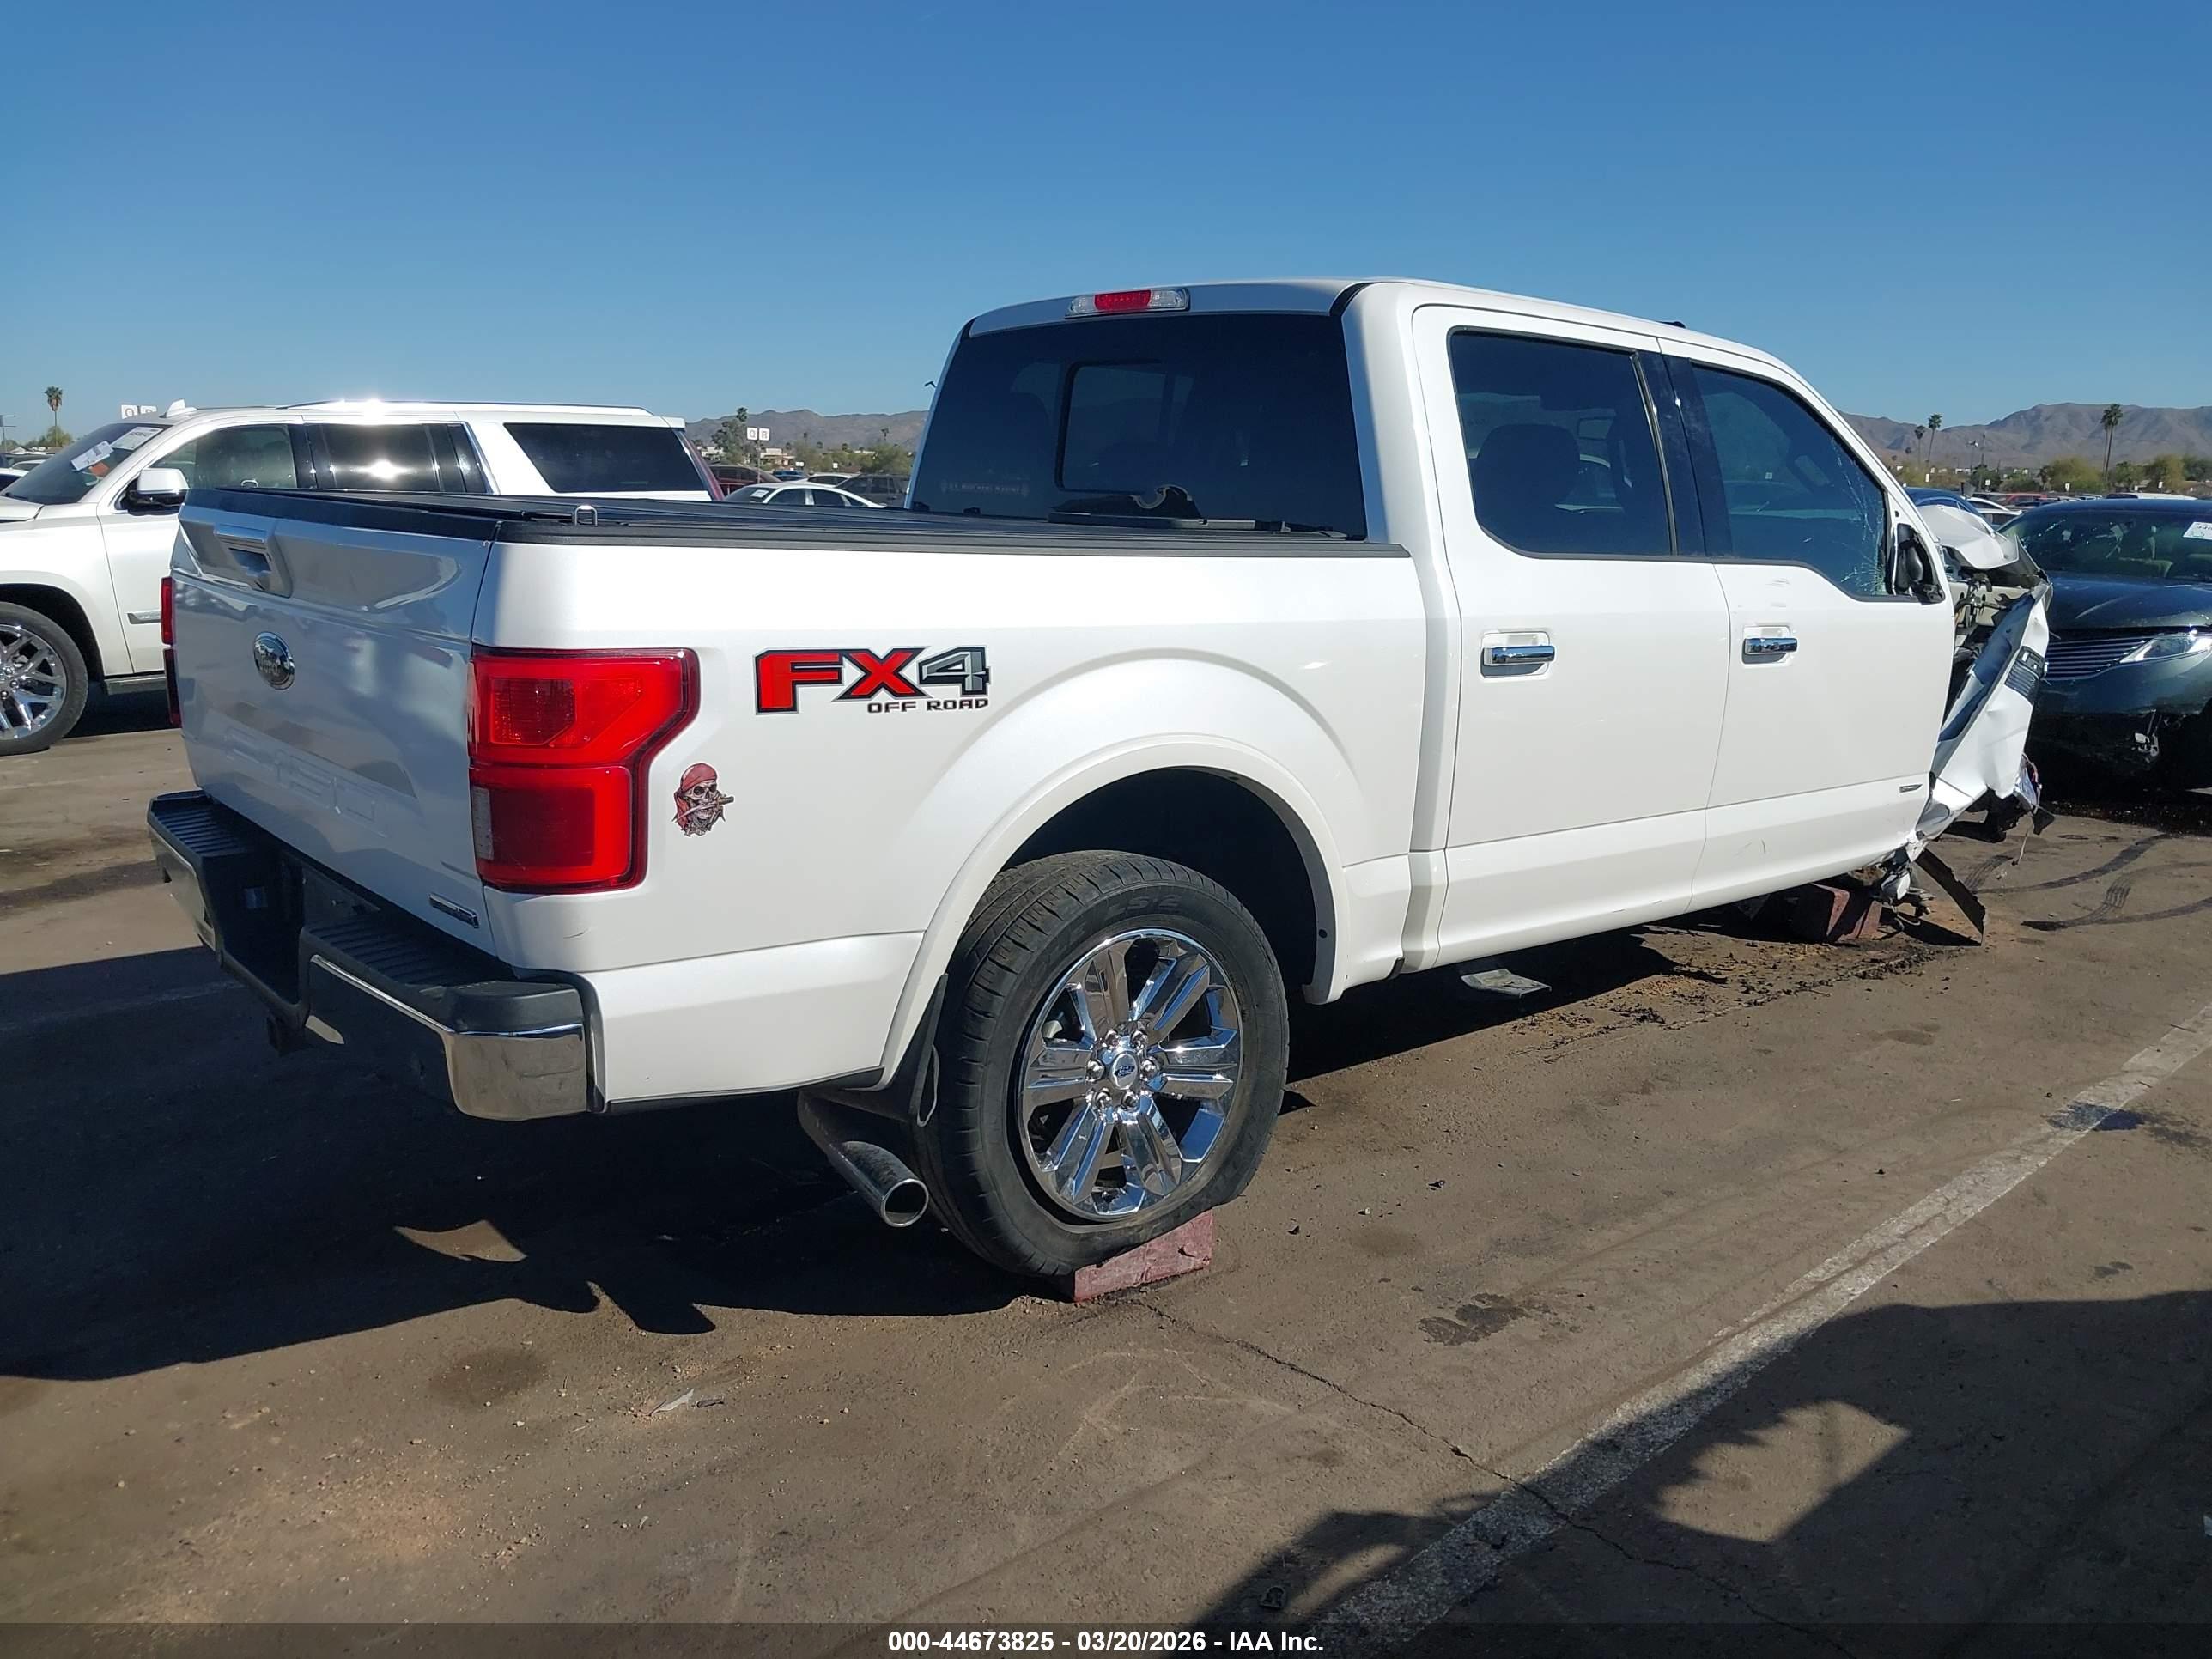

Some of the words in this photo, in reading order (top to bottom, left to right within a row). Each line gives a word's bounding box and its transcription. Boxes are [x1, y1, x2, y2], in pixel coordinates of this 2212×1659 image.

[754, 646, 991, 714] FX4
[867, 700, 916, 714] OFF
[926, 697, 989, 712] ROAD
